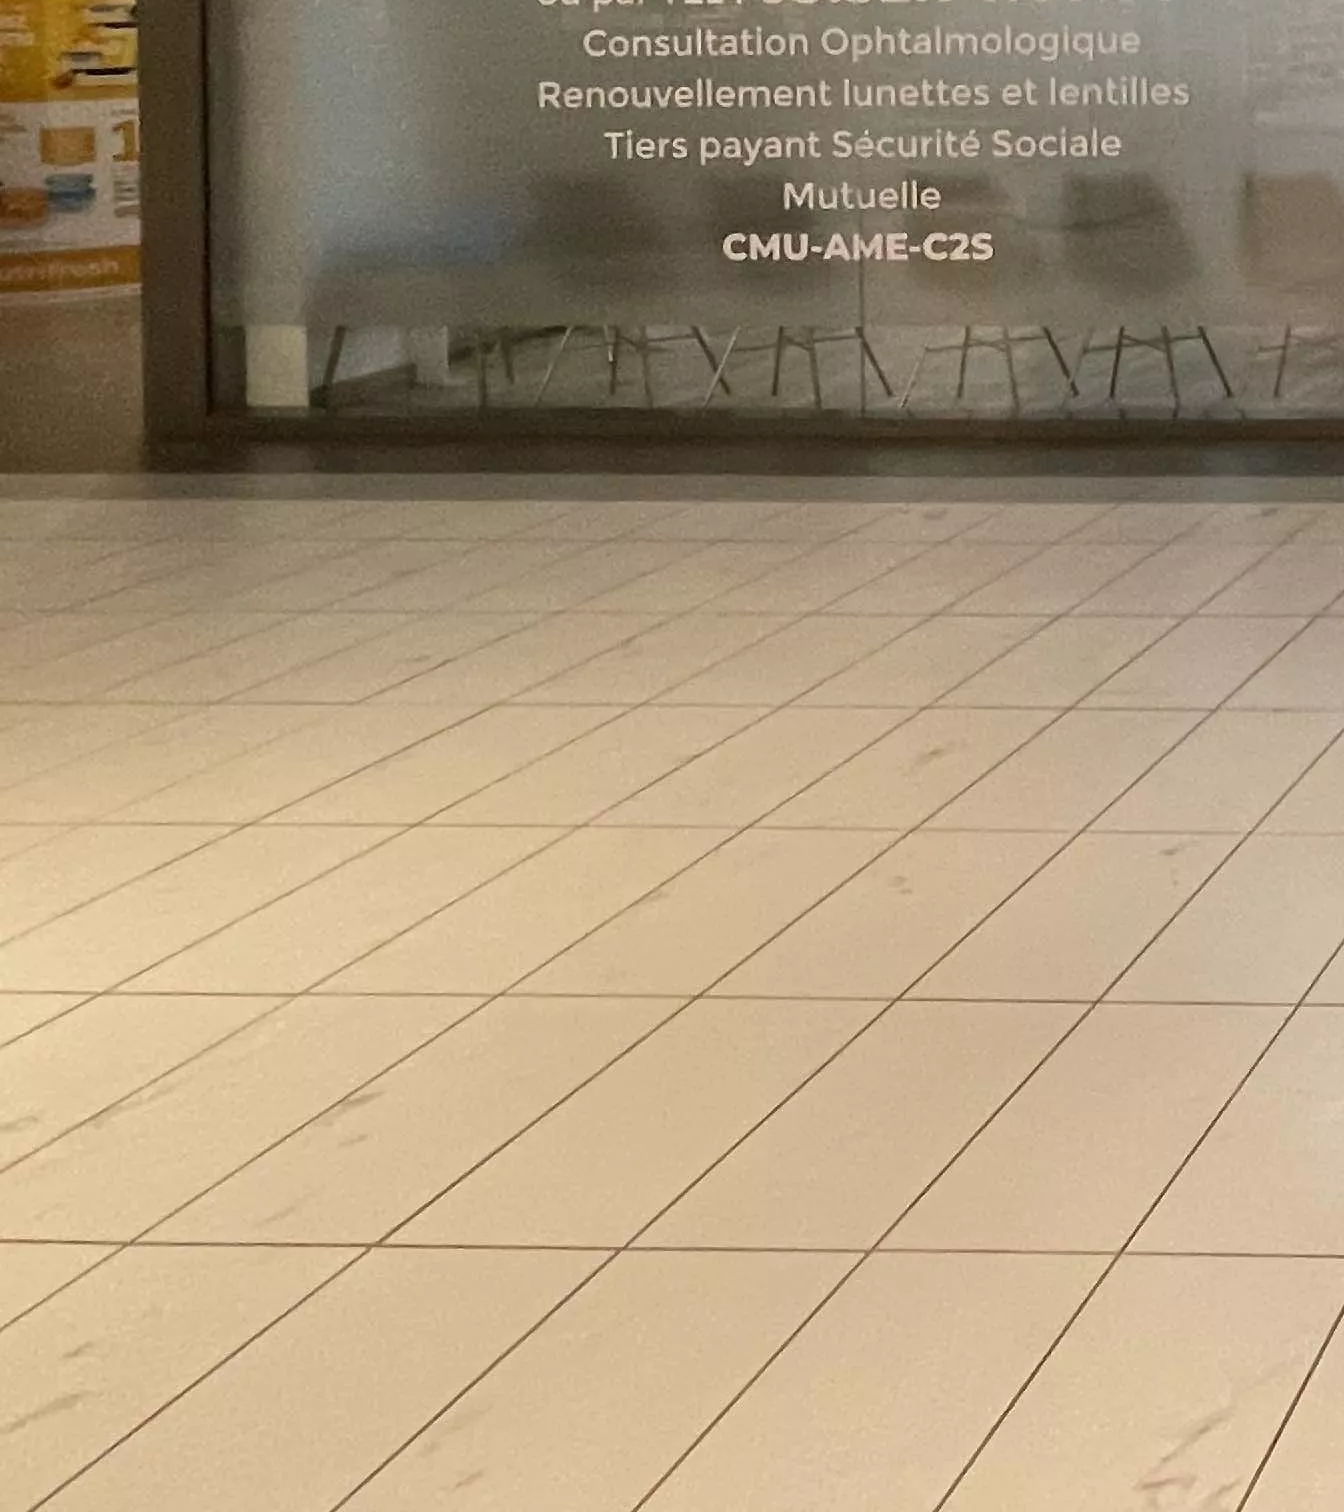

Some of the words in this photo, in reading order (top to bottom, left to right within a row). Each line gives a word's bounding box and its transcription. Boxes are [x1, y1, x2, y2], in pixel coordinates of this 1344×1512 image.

[582, 26, 809, 57] Consultation
[820, 24, 1143, 63] Ophtalmologique
[537, 78, 833, 109] Renouvellement
[842, 78, 991, 108] lunettes
[1001, 78, 1039, 107] et
[1049, 76, 1191, 107] lentilles
[603, 129, 689, 159] Tiers
[699, 131, 822, 167] payant
[831, 128, 982, 158] Sécurité
[991, 127, 1123, 157] Sociale
[782, 180, 942, 211] Mutuelle
[721, 231, 996, 263] CMU-AME-C2S
